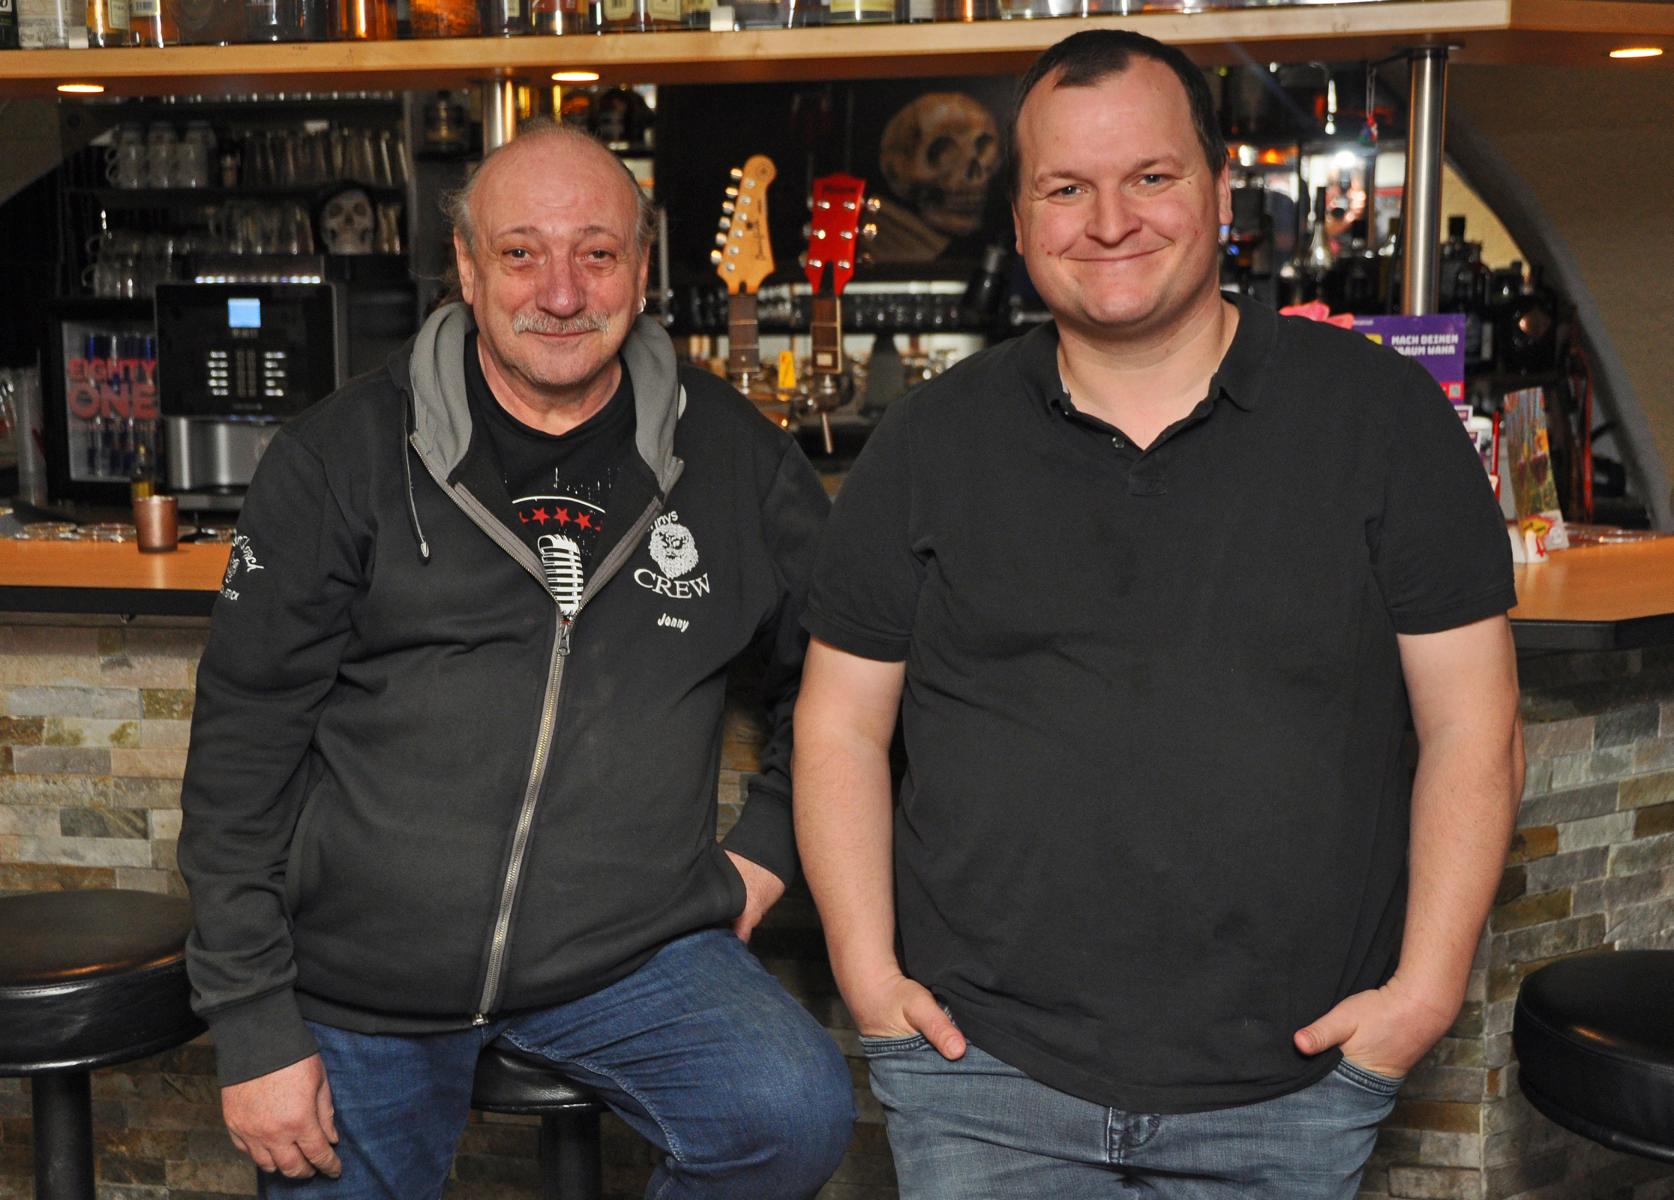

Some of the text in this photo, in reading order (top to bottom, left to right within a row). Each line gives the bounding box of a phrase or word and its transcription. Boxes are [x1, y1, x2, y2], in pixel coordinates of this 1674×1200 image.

[1391, 334, 1419, 346] MACH
[69, 358, 157, 381] EIGHTY
[69, 383, 159, 419] ONE
[633, 568, 711, 599] CREW
[657, 613, 690, 633] Jonny
